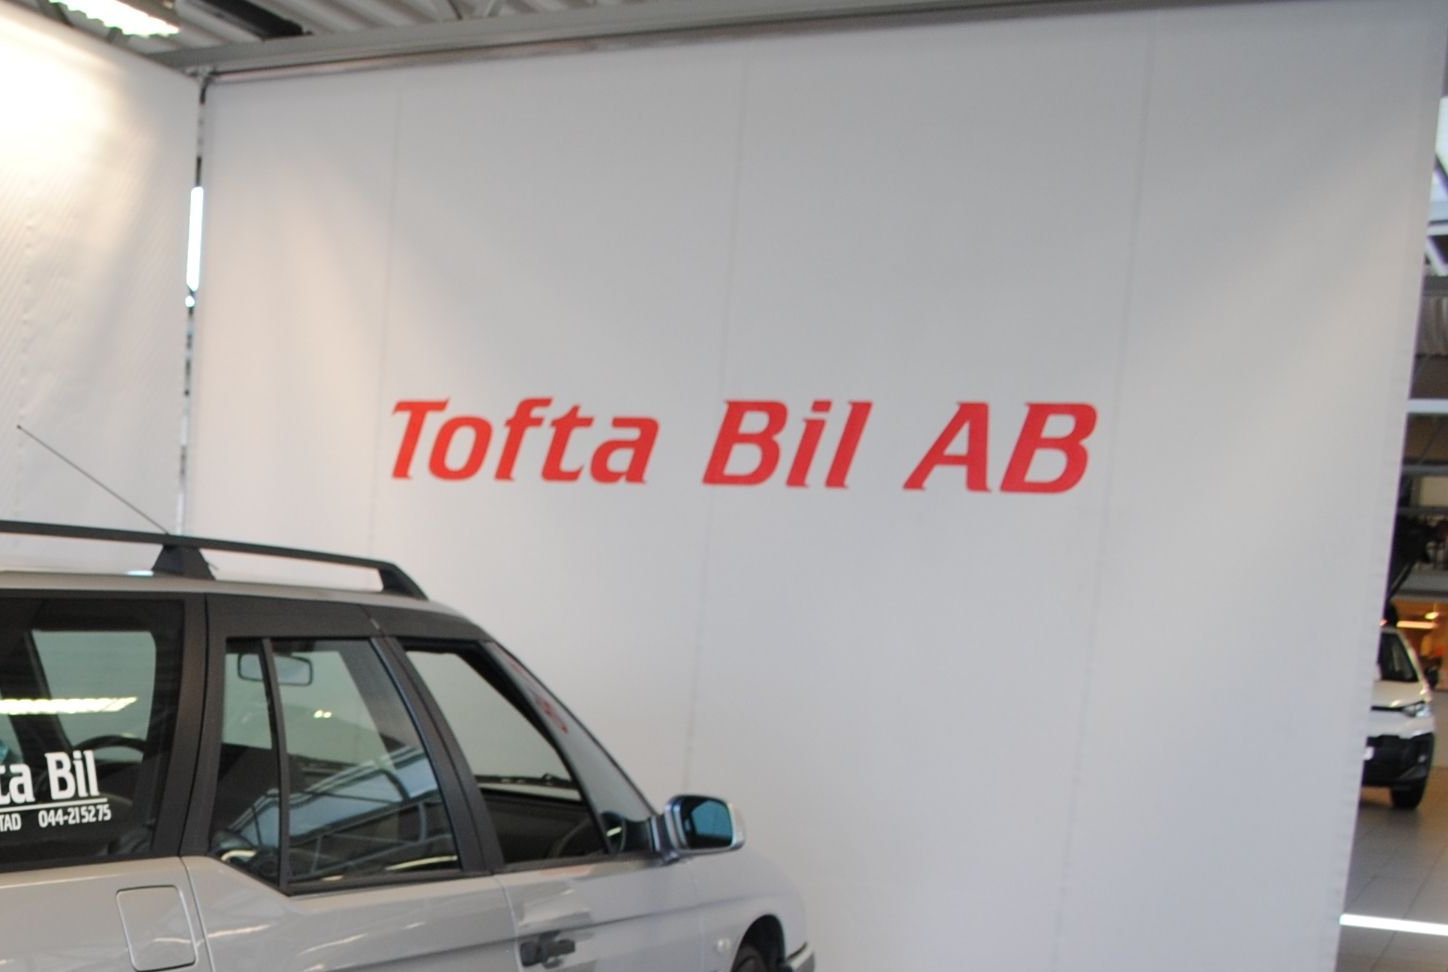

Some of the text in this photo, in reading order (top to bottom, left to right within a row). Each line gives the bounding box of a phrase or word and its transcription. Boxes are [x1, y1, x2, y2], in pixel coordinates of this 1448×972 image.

[392, 397, 1098, 494] Tofta Bil AB
[44, 750, 101, 800] Bil
